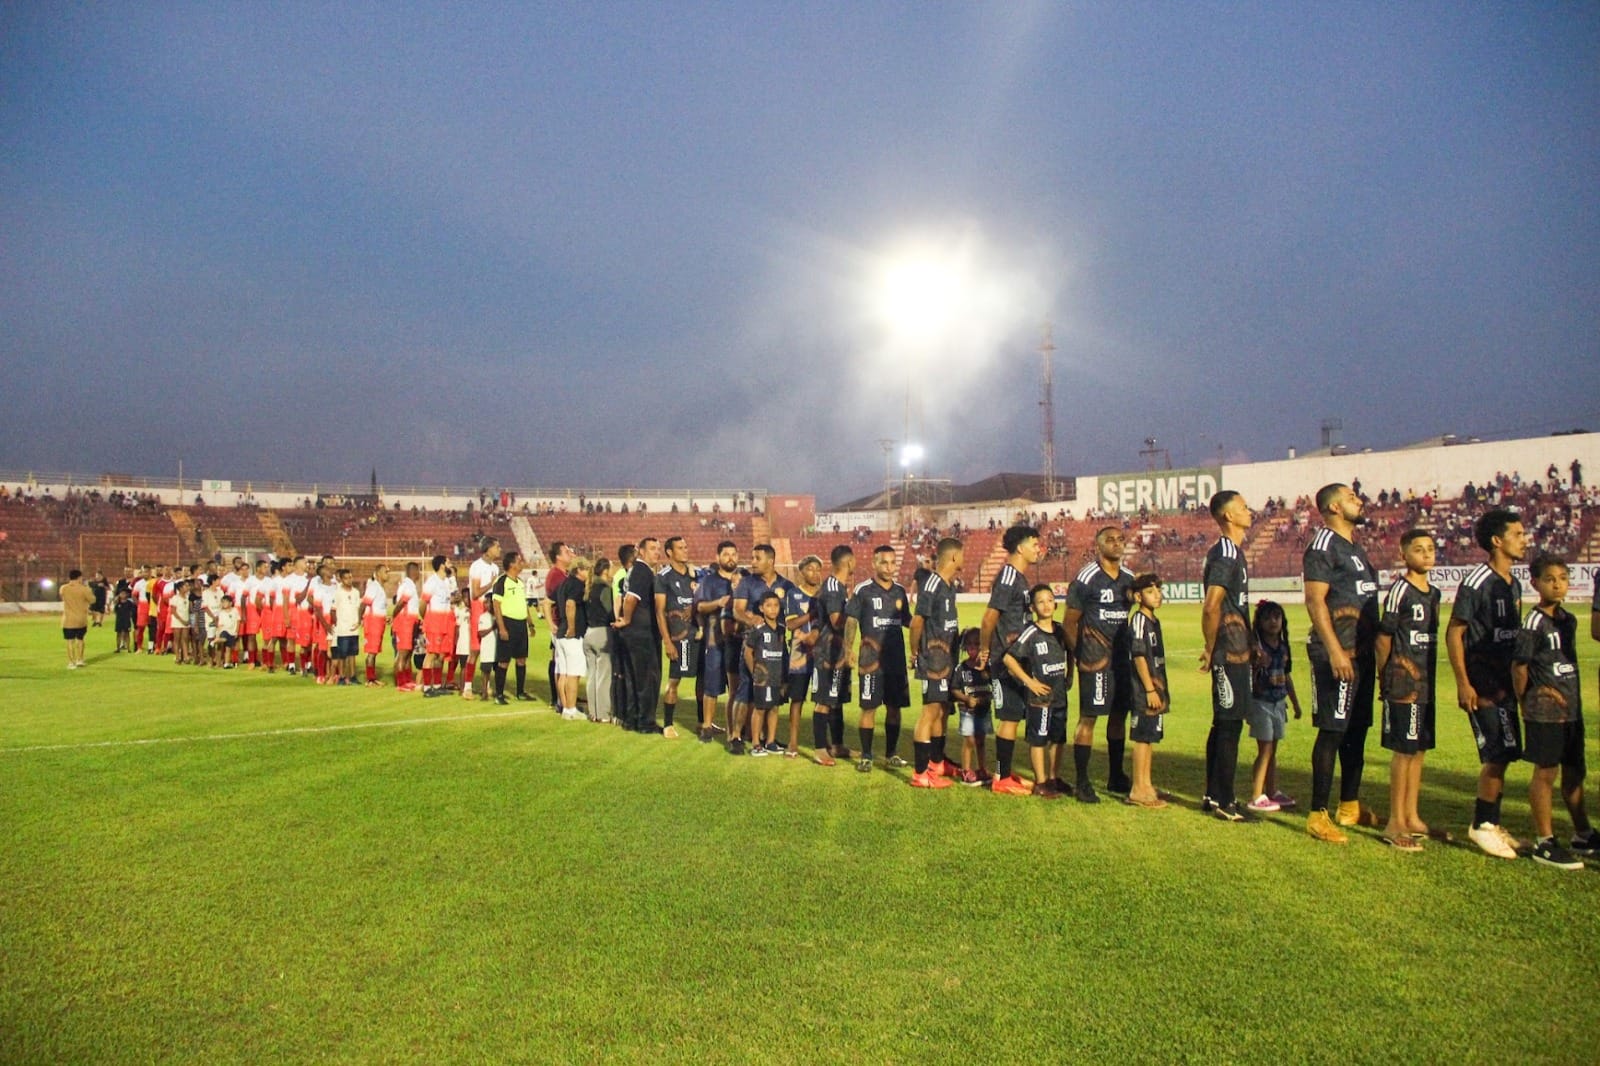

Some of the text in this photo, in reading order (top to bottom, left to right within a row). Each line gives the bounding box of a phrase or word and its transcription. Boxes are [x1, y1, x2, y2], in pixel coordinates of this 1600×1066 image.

[1103, 474, 1217, 513] SERMED
[872, 597, 883, 610] 10
[1100, 589, 1114, 603] 20
[1412, 603, 1425, 622] 13
[1496, 599, 1506, 617] 11
[1548, 632, 1561, 650] 11
